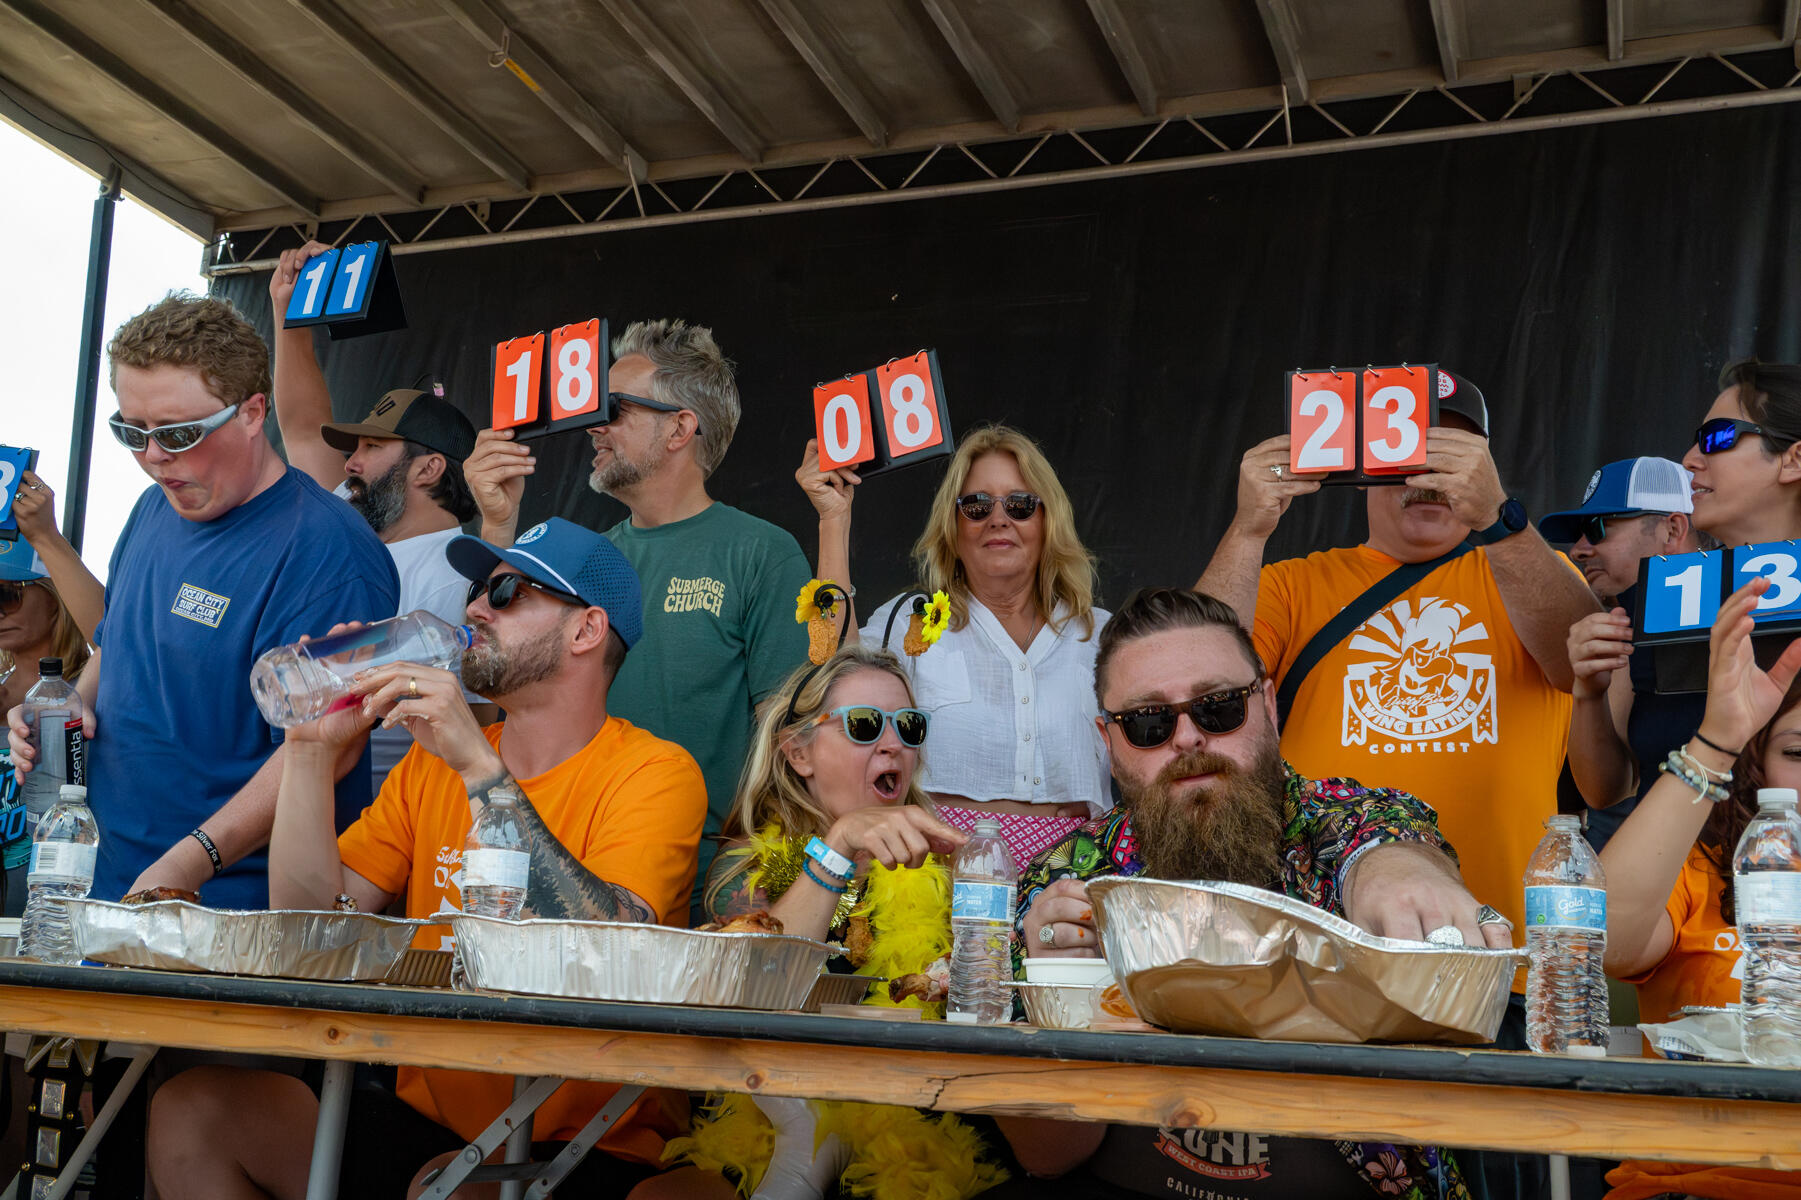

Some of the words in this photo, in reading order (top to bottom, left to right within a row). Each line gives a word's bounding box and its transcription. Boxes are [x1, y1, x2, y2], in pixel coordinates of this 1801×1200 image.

[1297, 386, 1420, 469] 23
[182, 588, 206, 603] OCEAN
[205, 595, 225, 609] CITY
[667, 576, 726, 599] SUBMERGE
[179, 599, 197, 611] SURF
[196, 605, 216, 619] CLUB
[664, 591, 723, 618] CHURCH
[1361, 701, 1407, 733] WING
[1412, 698, 1478, 735] EATING
[71, 730, 83, 787] ssentia
[1369, 742, 1470, 755] CONTEST
[196, 831, 214, 850] Silver
[210, 848, 219, 863] Fox
[1558, 896, 1585, 915] Gold
[1168, 1145, 1196, 1166] WEST
[1198, 1163, 1235, 1177] COAST
[1237, 1167, 1257, 1177] IPA
